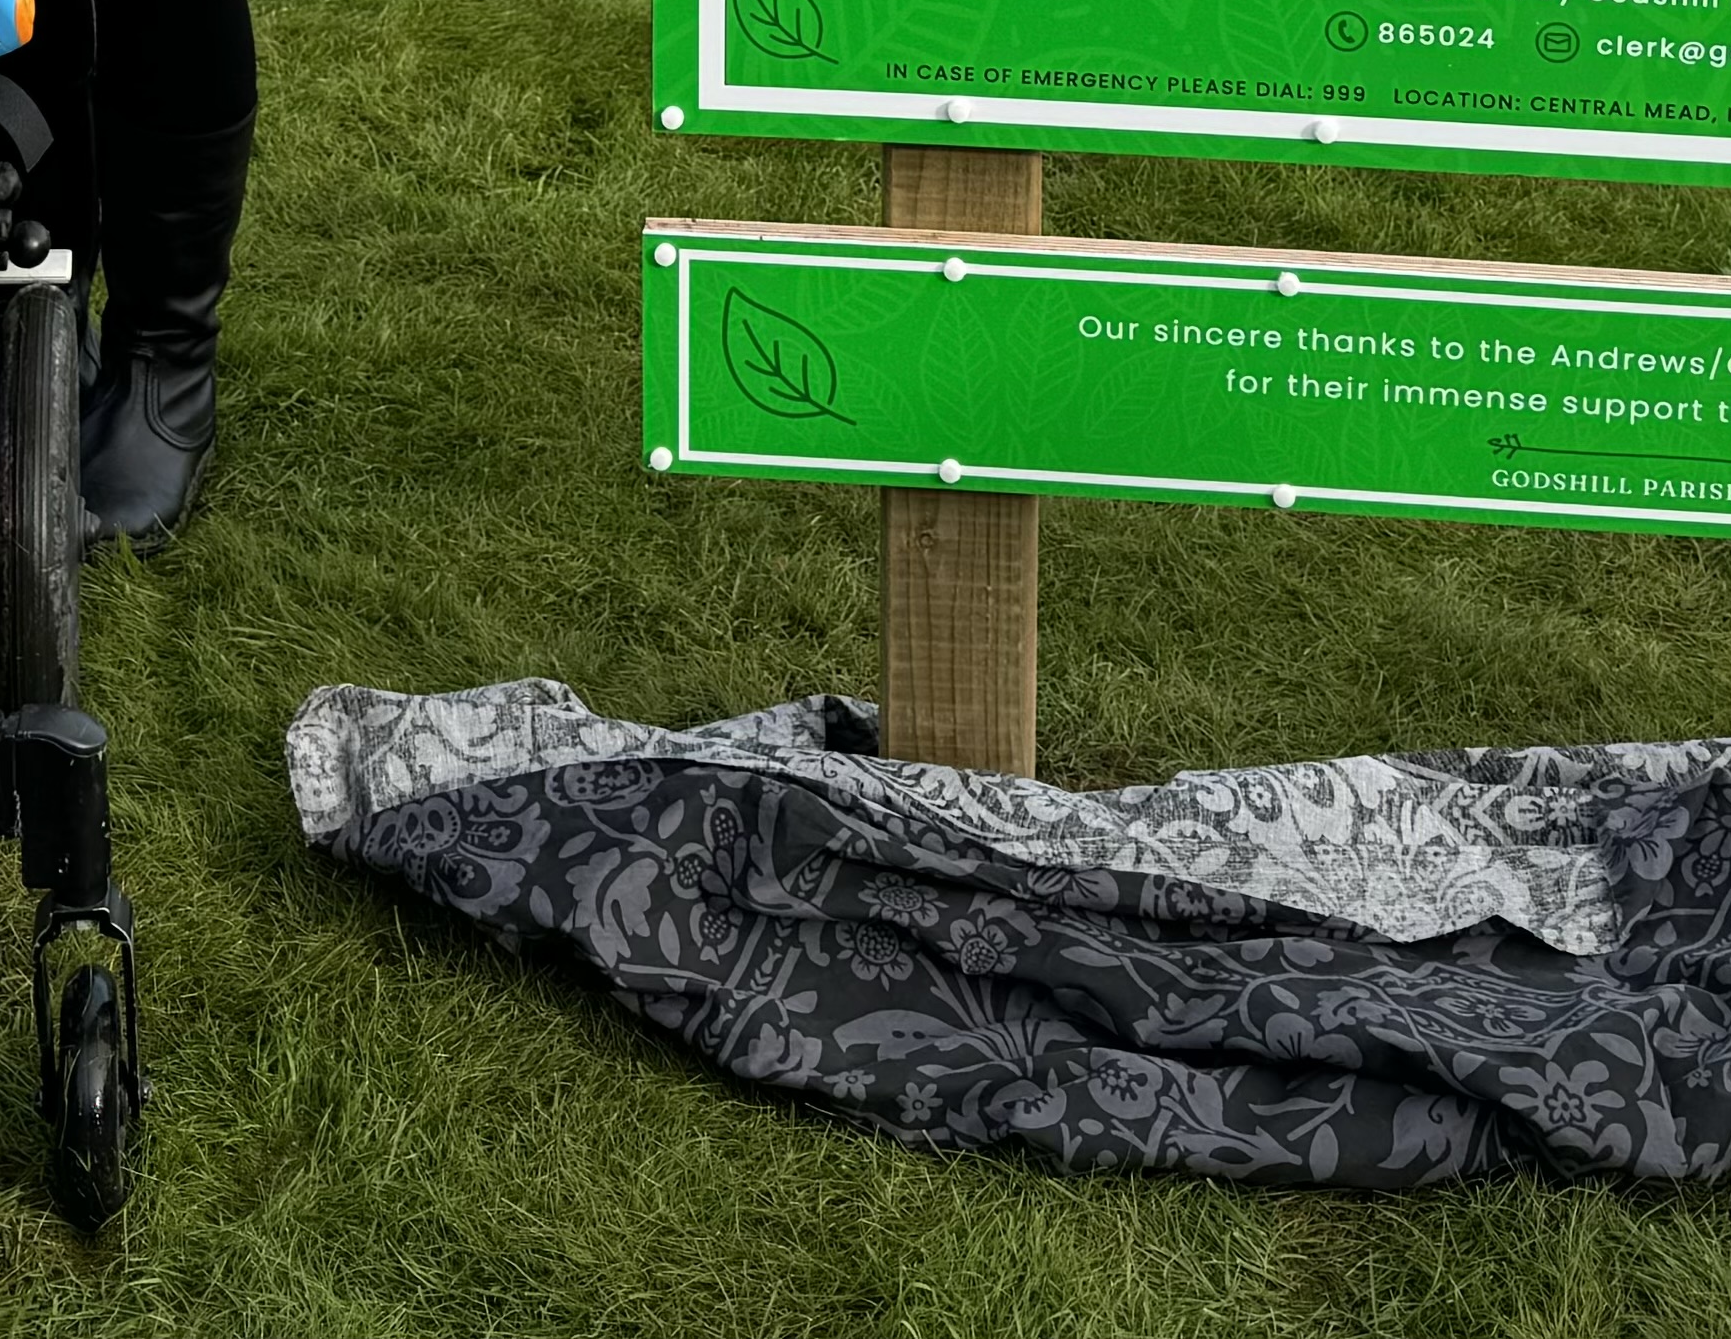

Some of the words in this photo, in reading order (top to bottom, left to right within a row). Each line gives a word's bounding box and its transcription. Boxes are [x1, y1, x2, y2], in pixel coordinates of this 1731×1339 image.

[1377, 21, 1496, 50] 865024
[885, 62, 909, 80] IN
[915, 63, 976, 83] CASE
[982, 66, 1013, 85] OF
[1020, 68, 1159, 92] EMERGENCY
[1166, 75, 1247, 98] PLEASE
[1255, 80, 1314, 101] DIAL:
[1322, 83, 1367, 103] 999
[1392, 87, 1522, 112] LOCATION:
[1529, 95, 1637, 119] CENTRAL
[1643, 101, 1718, 125] MEAD,
[1077, 314, 1141, 342] Our
[1153, 318, 1283, 350] sincere
[1296, 326, 1416, 358] thanks
[1429, 335, 1466, 361] to
[1478, 338, 1537, 366] the
[1225, 367, 1274, 396] for
[1286, 372, 1370, 401] their
[1382, 377, 1549, 413] immense
[1561, 394, 1704, 427] support
[1490, 468, 1634, 496] GODSHILL
